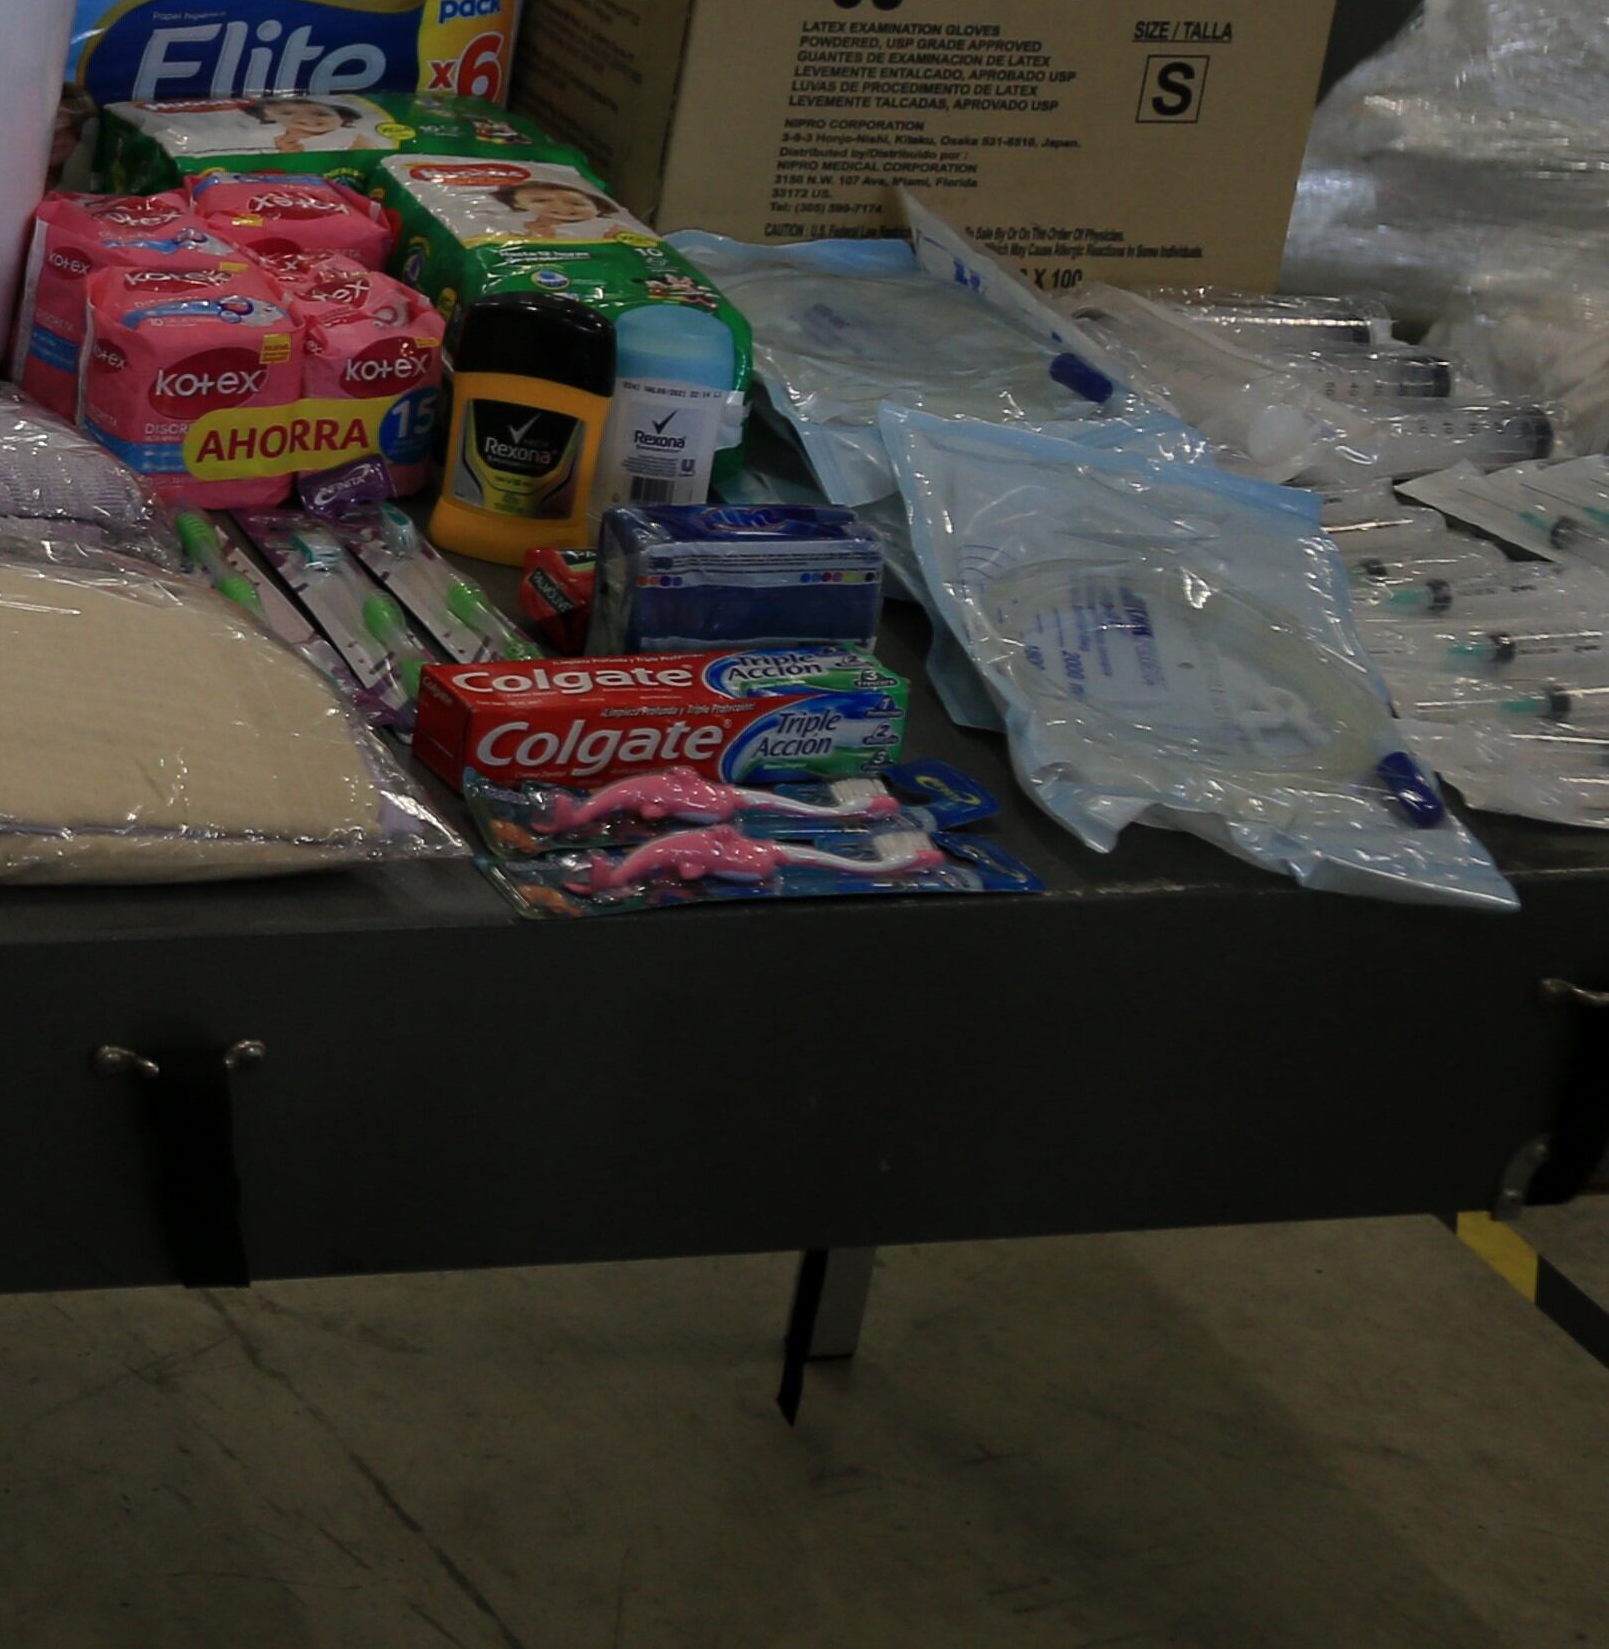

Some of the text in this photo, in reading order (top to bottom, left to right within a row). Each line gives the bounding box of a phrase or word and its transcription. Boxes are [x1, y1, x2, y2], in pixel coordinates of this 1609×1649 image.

[802, 20, 1000, 39] LATEX EXAMINATION GLOVES
[1134, 22, 1232, 41] SIZE / TALLA
[131, 19, 387, 97] Elite
[1152, 62, 1195, 116] S
[47, 253, 91, 276] kotex
[345, 354, 428, 381] kotex
[155, 370, 262, 397] kotex
[392, 396, 438, 438] 15
[196, 419, 368, 462] AHORRA
[484, 437, 552, 464] Rexona
[635, 431, 685, 448] Rexona
[739, 653, 816, 667] Triple
[452, 665, 693, 693] Colgate
[777, 710, 841, 738] Triple
[478, 719, 723, 776] Colgate
